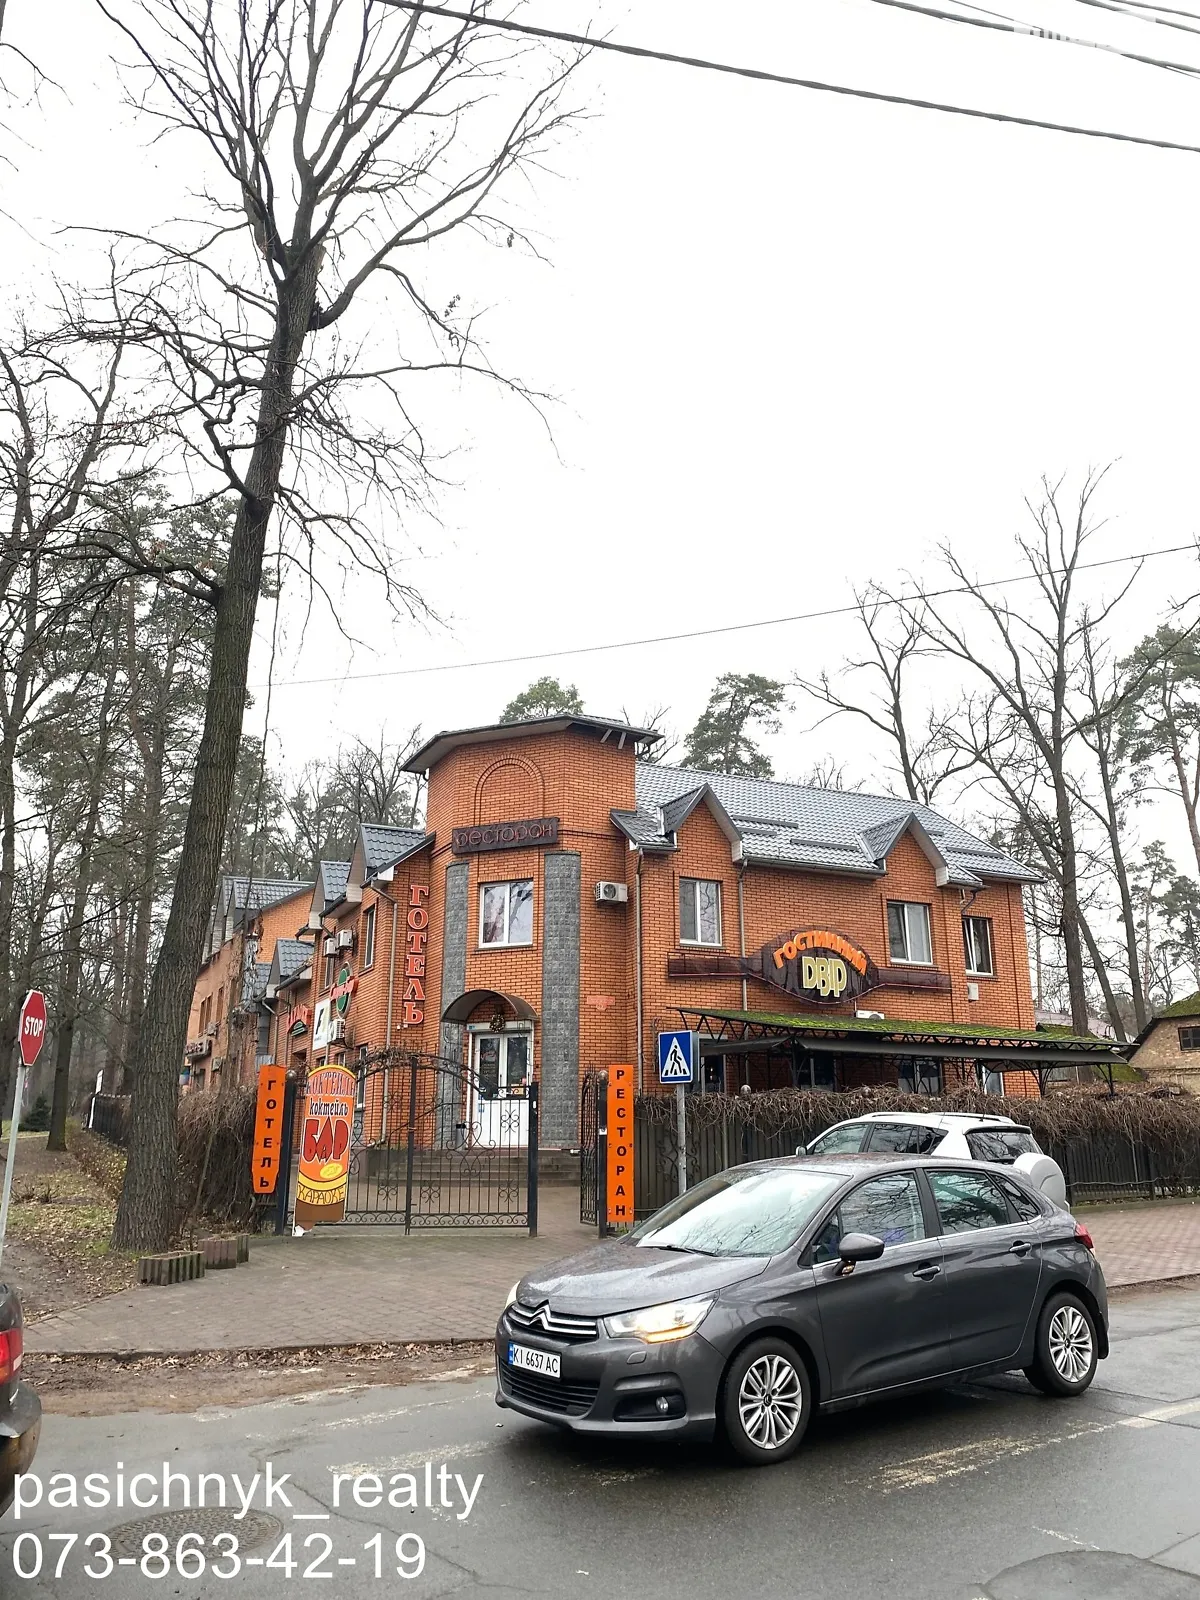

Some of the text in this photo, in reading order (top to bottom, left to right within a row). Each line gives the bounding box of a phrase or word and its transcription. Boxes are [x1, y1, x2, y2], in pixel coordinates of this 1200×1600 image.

[403, 884, 429, 1025] ГОТЕЛЬ
[773, 930, 867, 976] ГОСТИННИЙ
[24, 1015, 43, 1037] STOP
[260, 1080, 277, 1187] ГОТЕЛЬ
[302, 1117, 349, 1163] БАР
[615, 1069, 627, 1216] РЕСТОРАН
[298, 1185, 344, 1204] КАРАОКЕ
[526, 1351, 544, 1369] 6637
